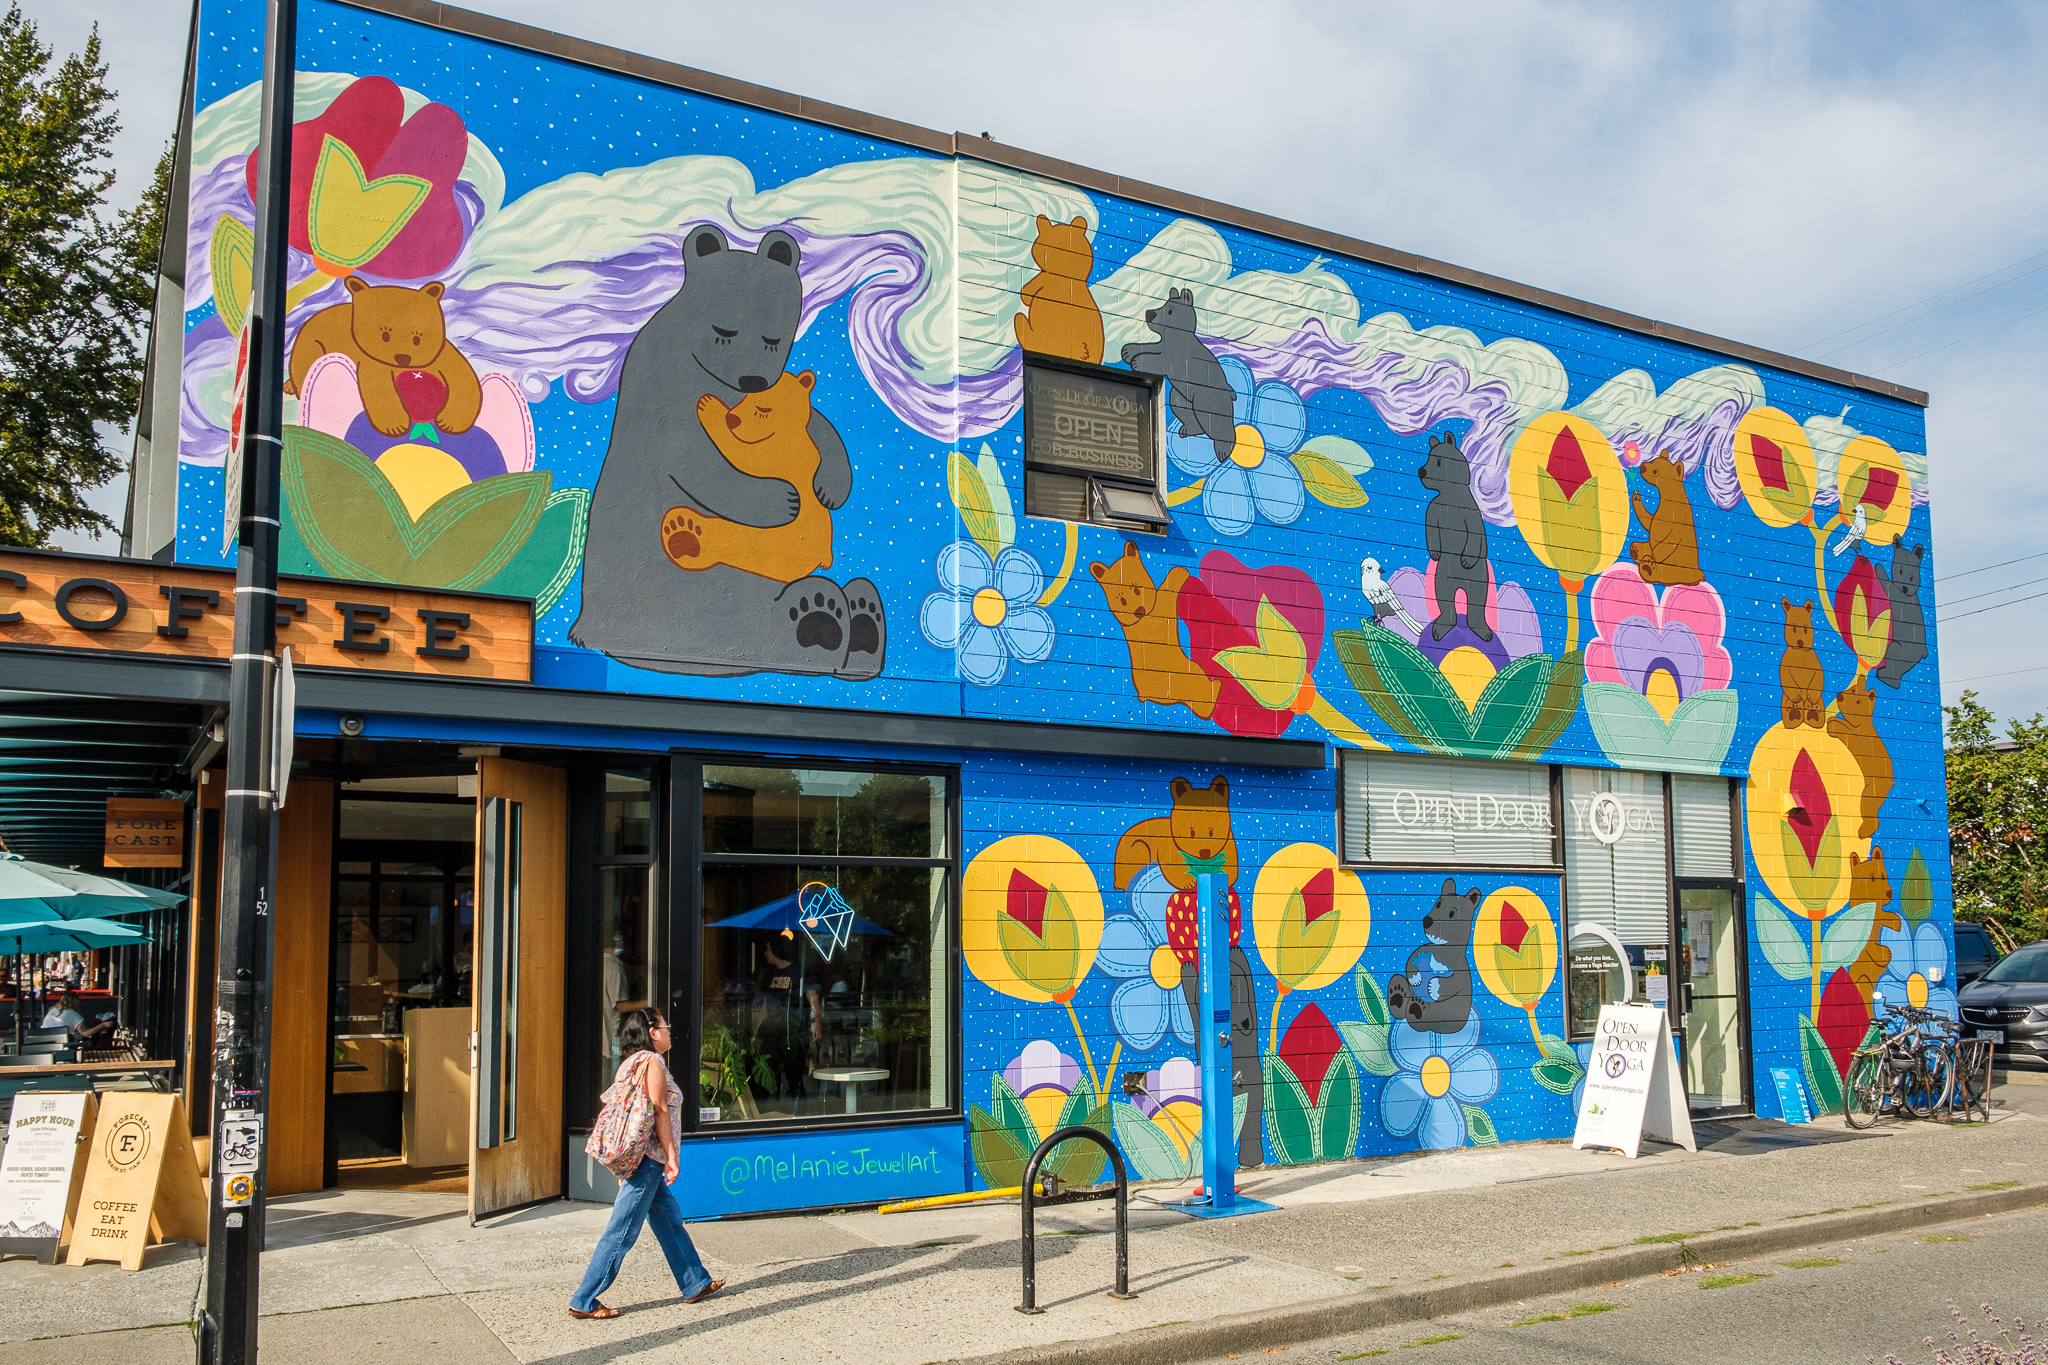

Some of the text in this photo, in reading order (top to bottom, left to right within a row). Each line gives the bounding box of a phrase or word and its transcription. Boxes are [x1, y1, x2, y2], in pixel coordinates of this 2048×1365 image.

[1029, 382, 1062, 398] OPEN
[1066, 389, 1101, 405] DOOR
[1054, 413, 1122, 445] OPEN
[1031, 438, 1144, 470] FOR BUSINESS
[114, 819, 176, 830] FORE
[1393, 790, 1656, 846] OPEN DOOR YOGA
[113, 834, 175, 846] CAST
[260, 886, 265, 900] 1
[256, 901, 268, 916] 52
[1602, 1018, 1638, 1034] OPEN
[1607, 1035, 1648, 1053] DOOR
[1598, 1053, 1644, 1079] YOGA
[1589, 1083, 1644, 1095] www.opendooryoga.ca
[1795, 1081, 1812, 1123] ARTIST
[16, 1115, 75, 1128] HAPPY HOUR
[113, 1113, 150, 1130] FORECAST
[107, 1159, 119, 1171] MAIN
[129, 1160, 141, 1171] VAN
[722, 1147, 942, 1196] @MelanieJewellArt
[93, 1200, 138, 1212] COFFEE
[100, 1214, 125, 1225] EAT
[91, 1227, 128, 1239] DRINK
